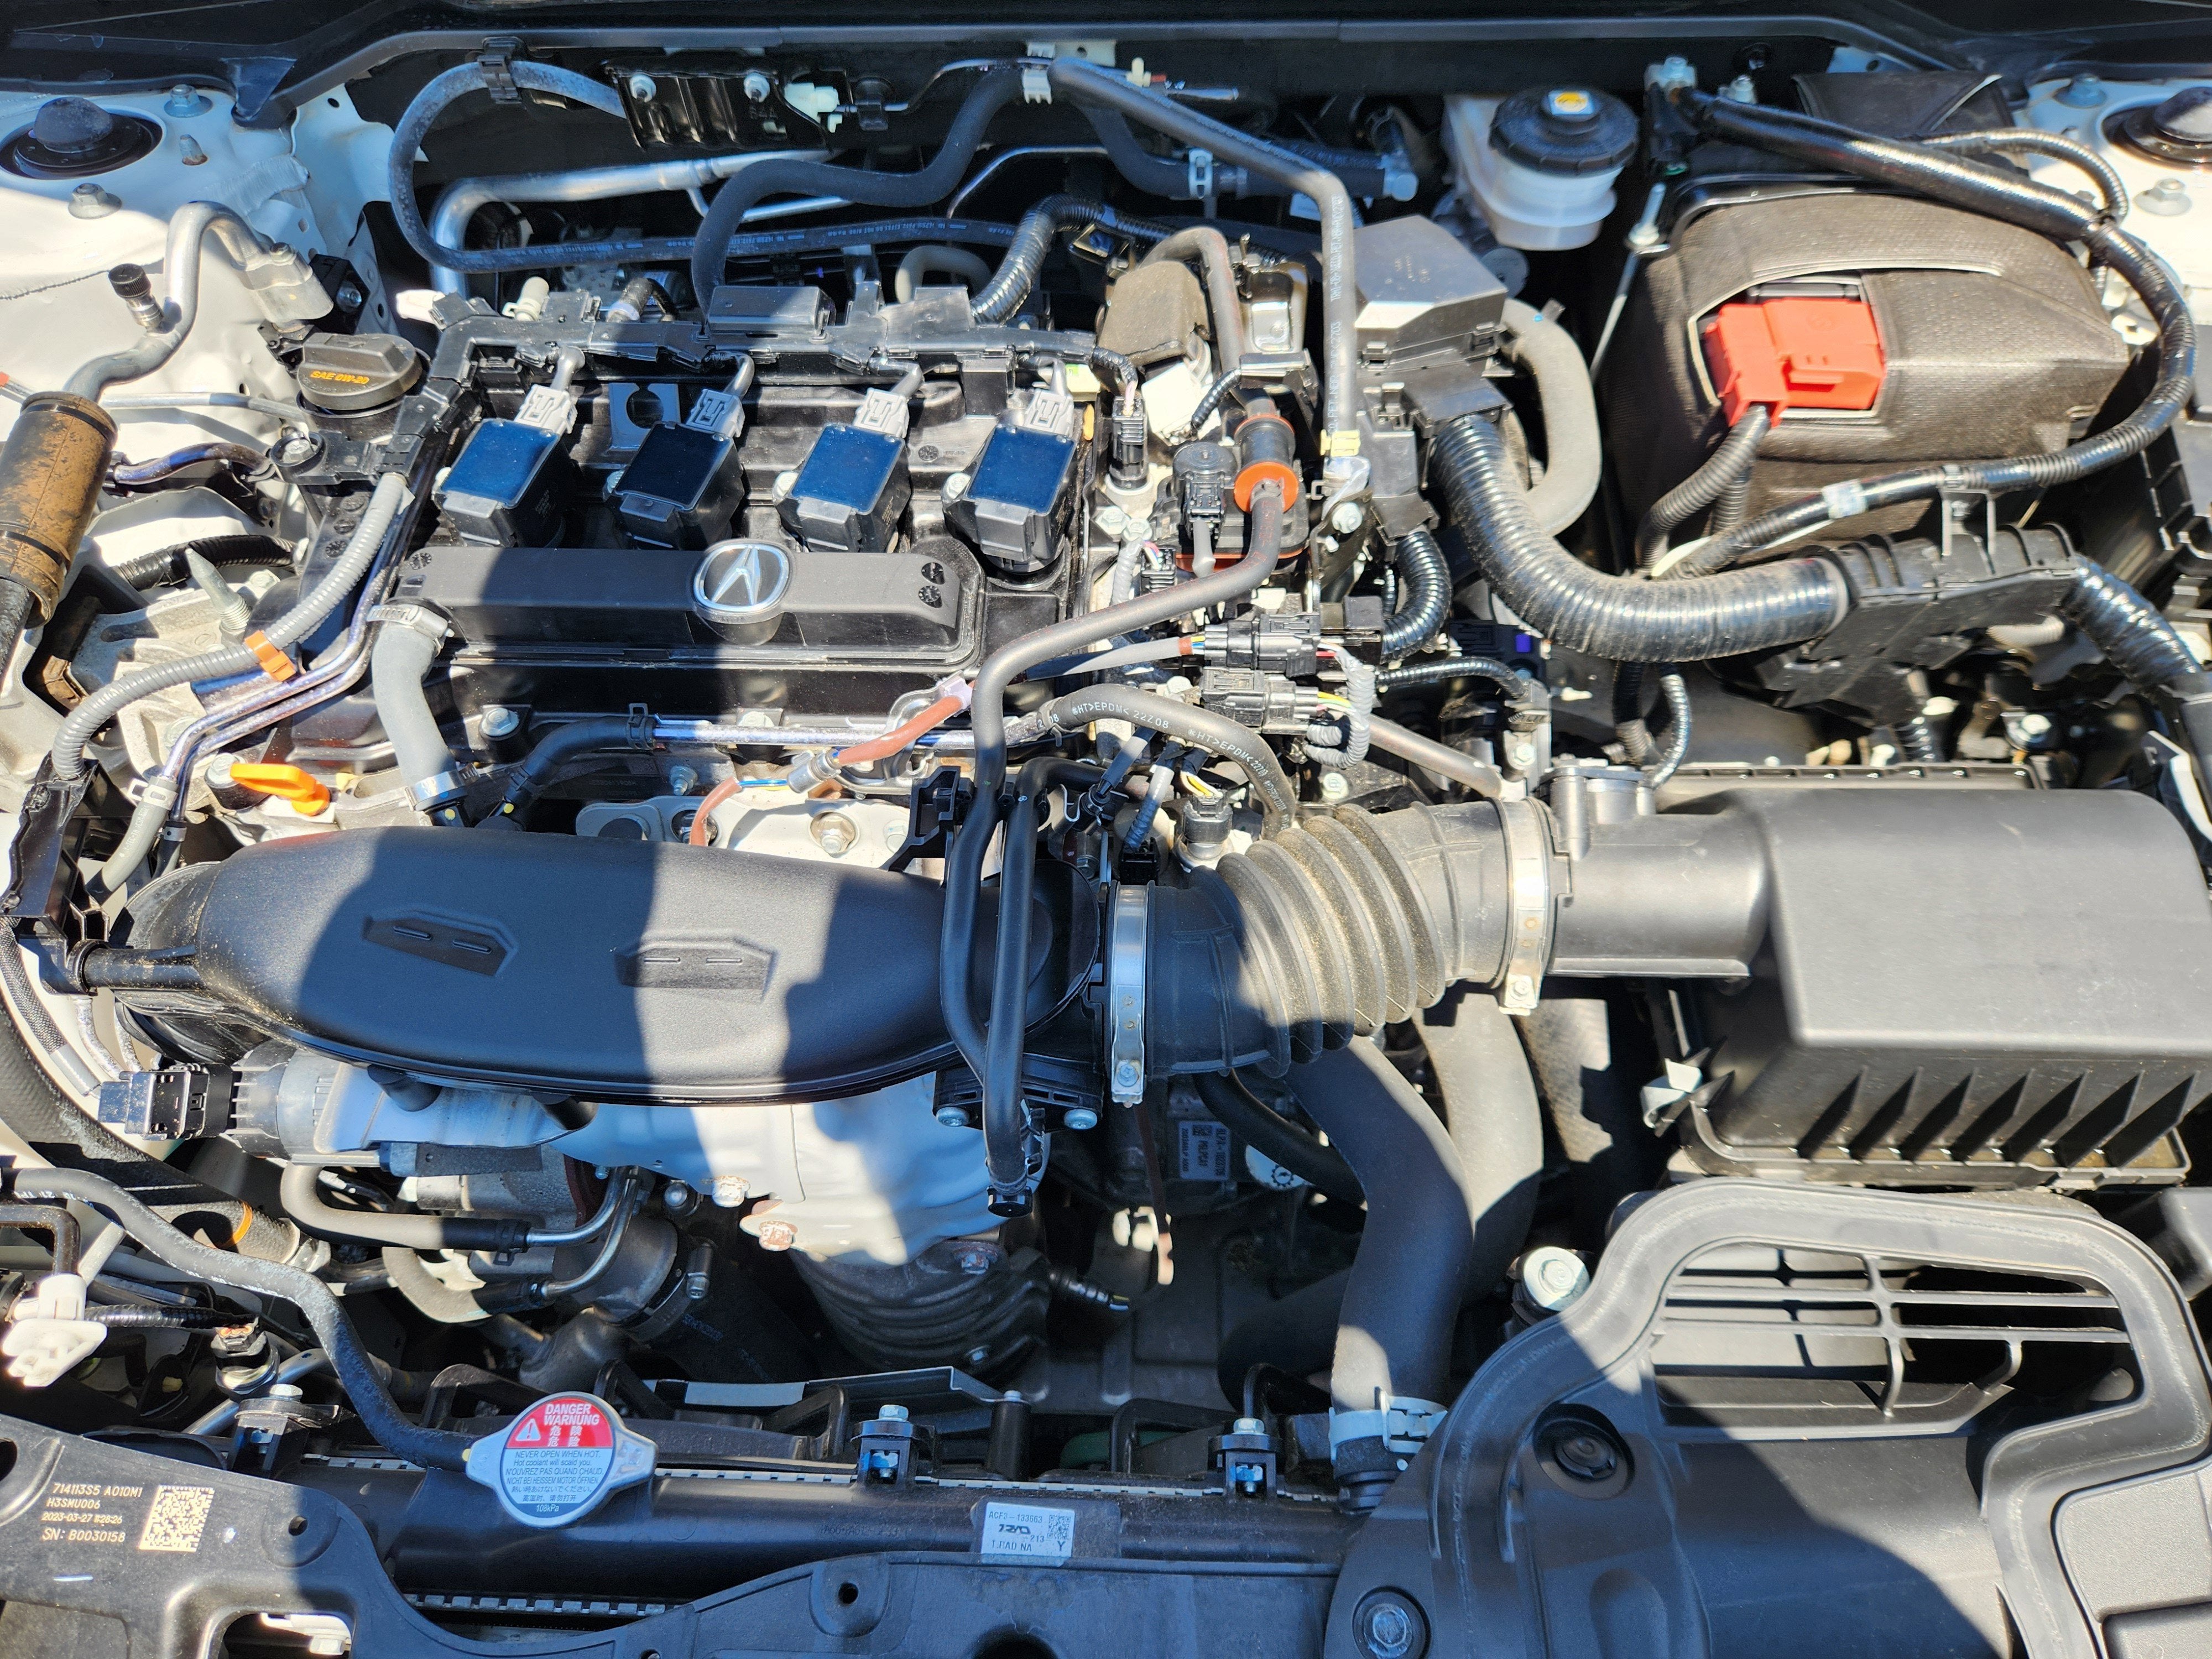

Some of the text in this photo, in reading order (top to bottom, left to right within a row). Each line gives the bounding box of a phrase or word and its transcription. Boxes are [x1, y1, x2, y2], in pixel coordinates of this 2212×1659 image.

[310, 371, 369, 384] SAE 0W-20
[545, 1404, 592, 1415] DANGER
[544, 1415, 600, 1426] WARNUNG
[515, 1450, 538, 1458] NEVER
[540, 1450, 562, 1458] OPEN
[562, 1450, 581, 1458] WHEN
[103, 1485, 143, 1497] A010M1
[46, 1498, 101, 1509] H3SMU006
[536, 1504, 560, 1512] 108kPa
[41, 1511, 93, 1523] 2023-03-27
[42, 1527, 126, 1542] SN: B0030158
[1021, 1543, 1032, 1551] NA
[1057, 1540, 1066, 1552] Y
